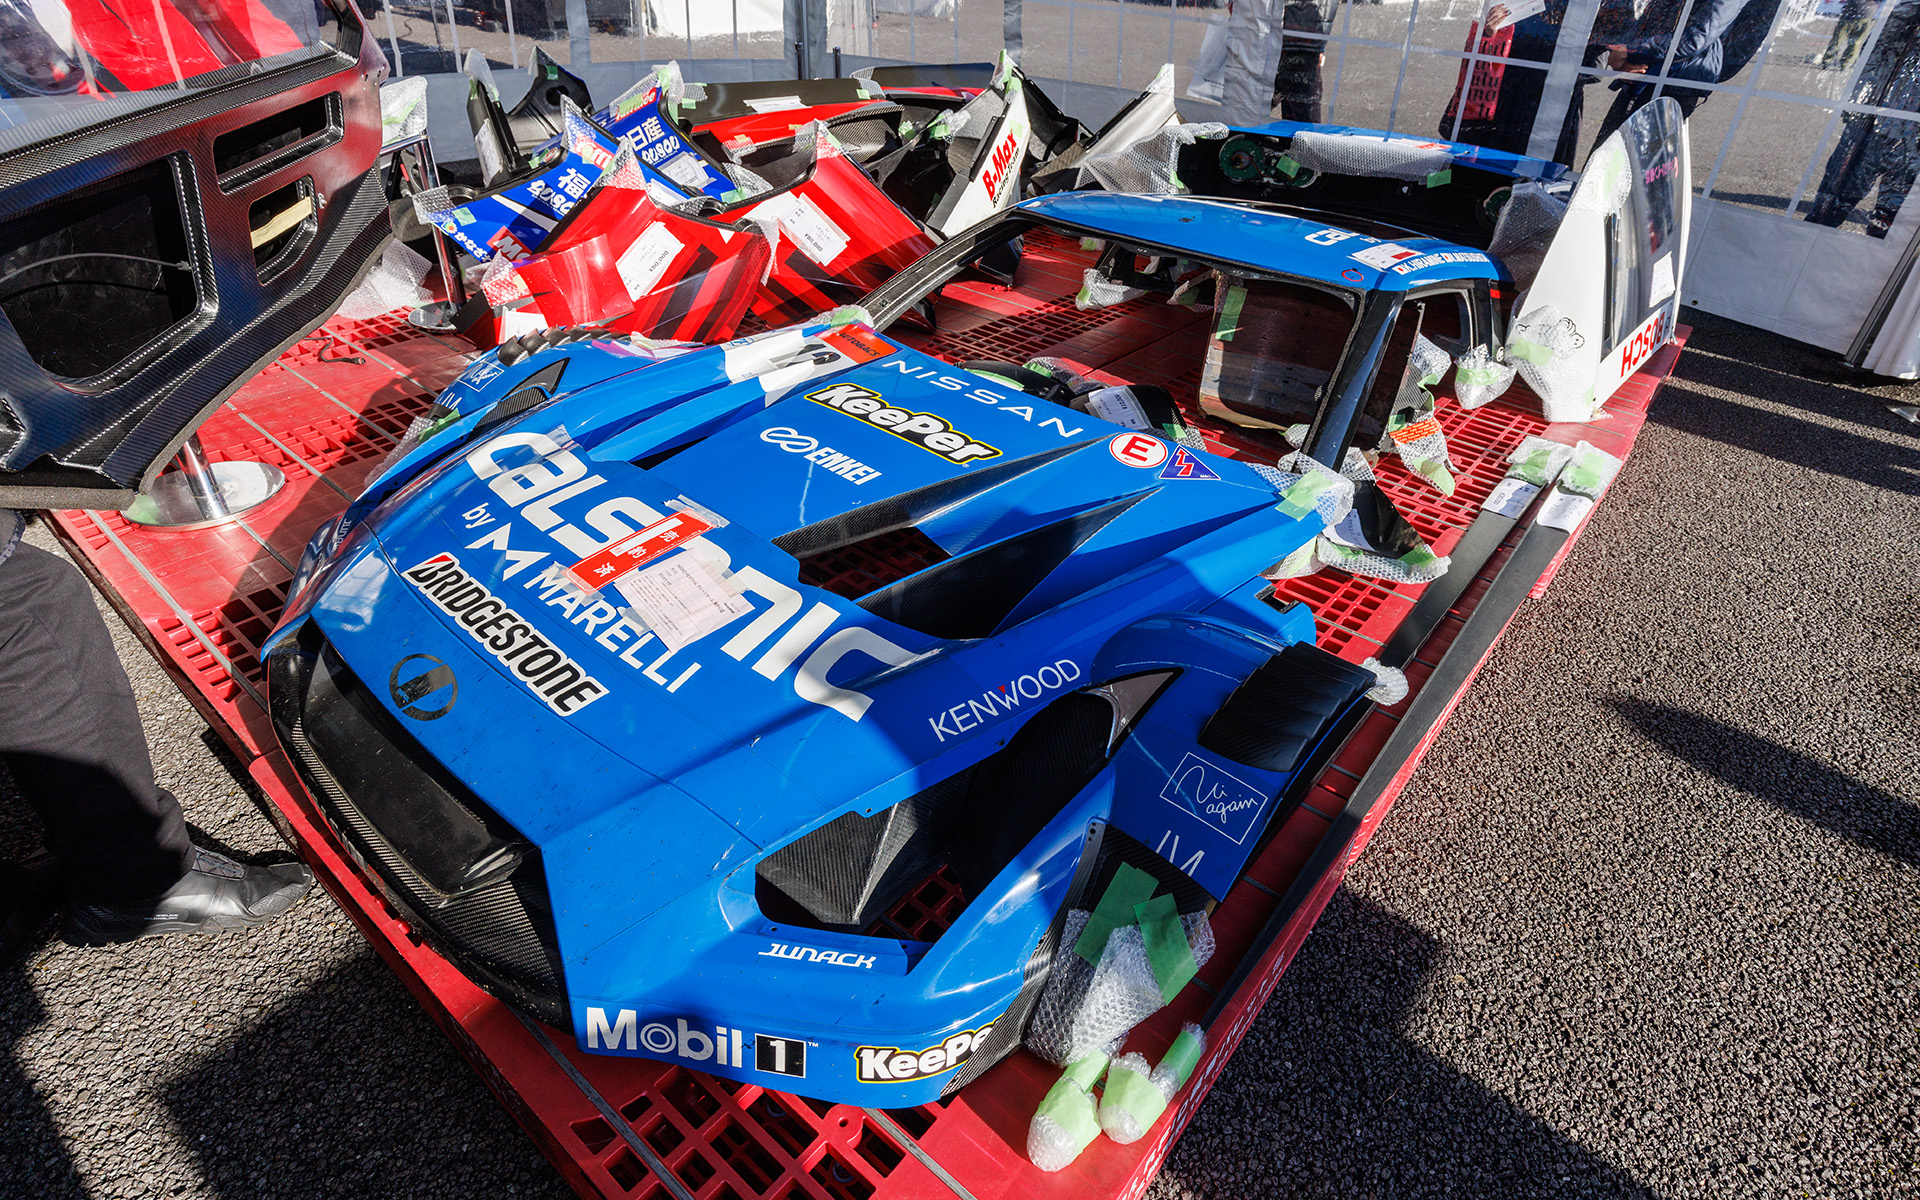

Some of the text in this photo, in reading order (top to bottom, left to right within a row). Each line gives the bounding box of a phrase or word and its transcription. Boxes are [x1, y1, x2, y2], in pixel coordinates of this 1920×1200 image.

[616, 116, 665, 151] 日産
[557, 167, 591, 200] 福
[982, 128, 1017, 201] B-Max
[838, 332, 881, 358] AUTOBACS
[1620, 311, 1665, 379] BOSCH
[806, 383, 1001, 463] KeePer
[882, 359, 1085, 438] NISSAN
[804, 446, 883, 486] ENKEI
[1120, 435, 1157, 462] E
[462, 502, 496, 529] by
[593, 530, 680, 577] 売約済
[403, 553, 609, 716] BRIDGESTONE
[523, 565, 702, 693] MARELLI
[928, 659, 1081, 742] KENWOOD
[586, 1007, 743, 1067] Mobil
